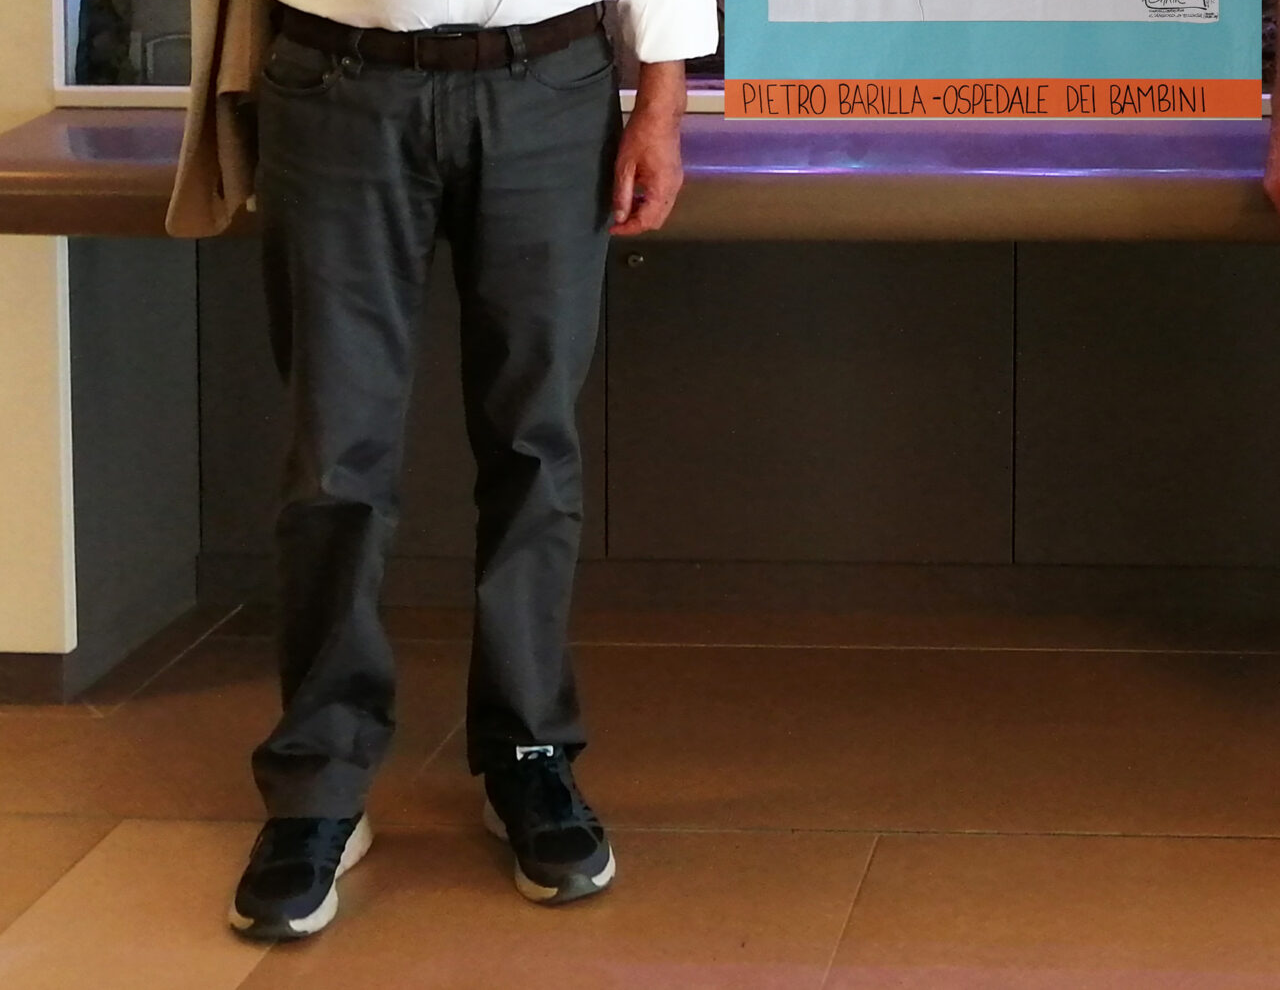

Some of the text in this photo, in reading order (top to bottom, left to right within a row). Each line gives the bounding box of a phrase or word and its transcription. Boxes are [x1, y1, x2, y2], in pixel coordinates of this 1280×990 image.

[742, 82, 827, 115] PIETRO
[838, 82, 927, 115] BARILLA
[1066, 84, 1096, 114] DEI
[1109, 83, 1206, 115] BAMBINI
